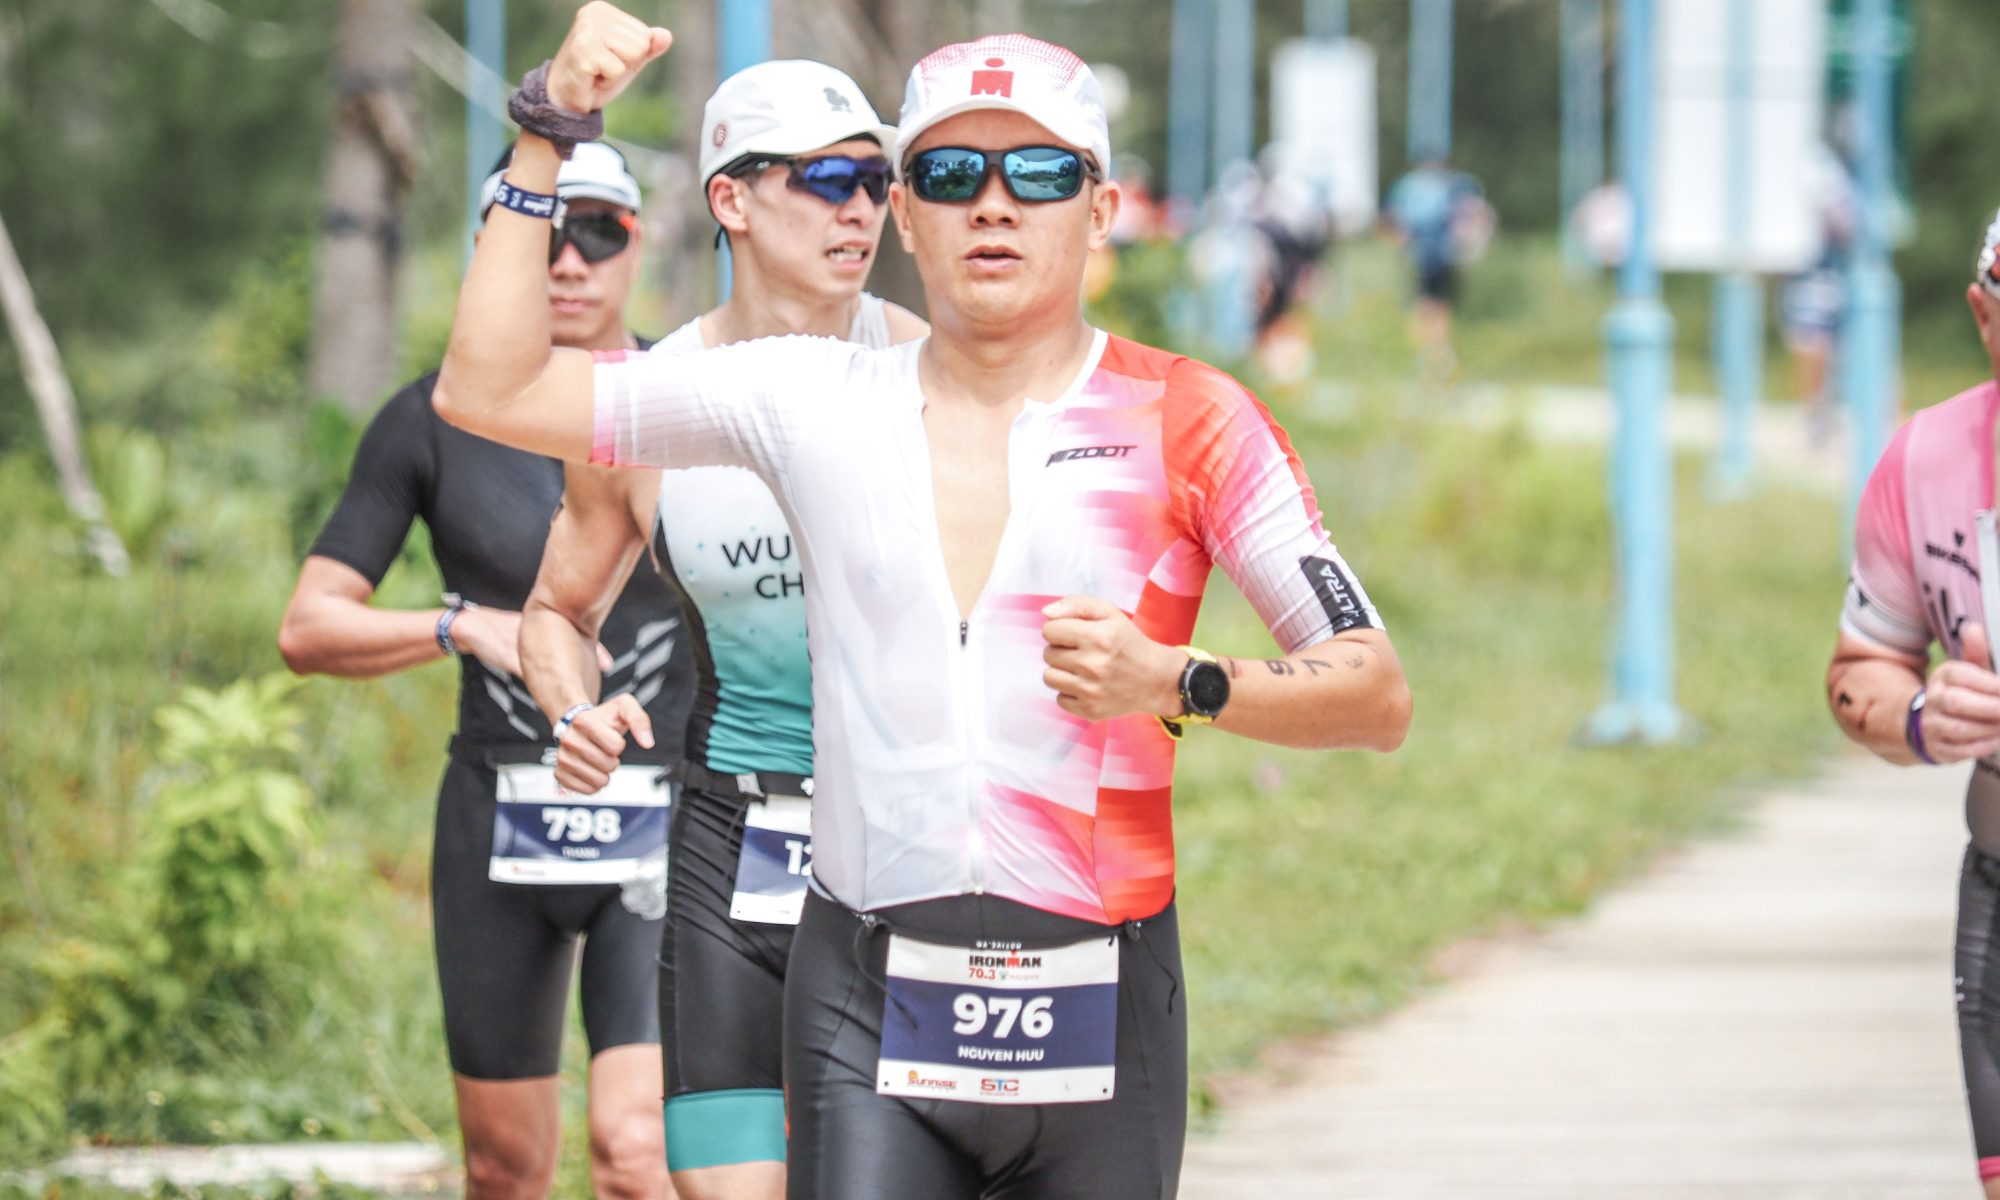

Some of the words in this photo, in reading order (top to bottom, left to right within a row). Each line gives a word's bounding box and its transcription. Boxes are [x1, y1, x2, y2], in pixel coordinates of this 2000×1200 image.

[1066, 445, 1138, 461] ZOOT
[722, 535, 791, 568] WU
[755, 572, 805, 600] CH
[541, 807, 622, 843] 798
[969, 954, 1042, 968] IRONMAN
[969, 967, 996, 980] 70.3
[953, 993, 1054, 1039] 976
[958, 1045, 1013, 1062] NGUYEN
[1015, 1048, 1044, 1062] HUU
[981, 1079, 1020, 1091] STC
